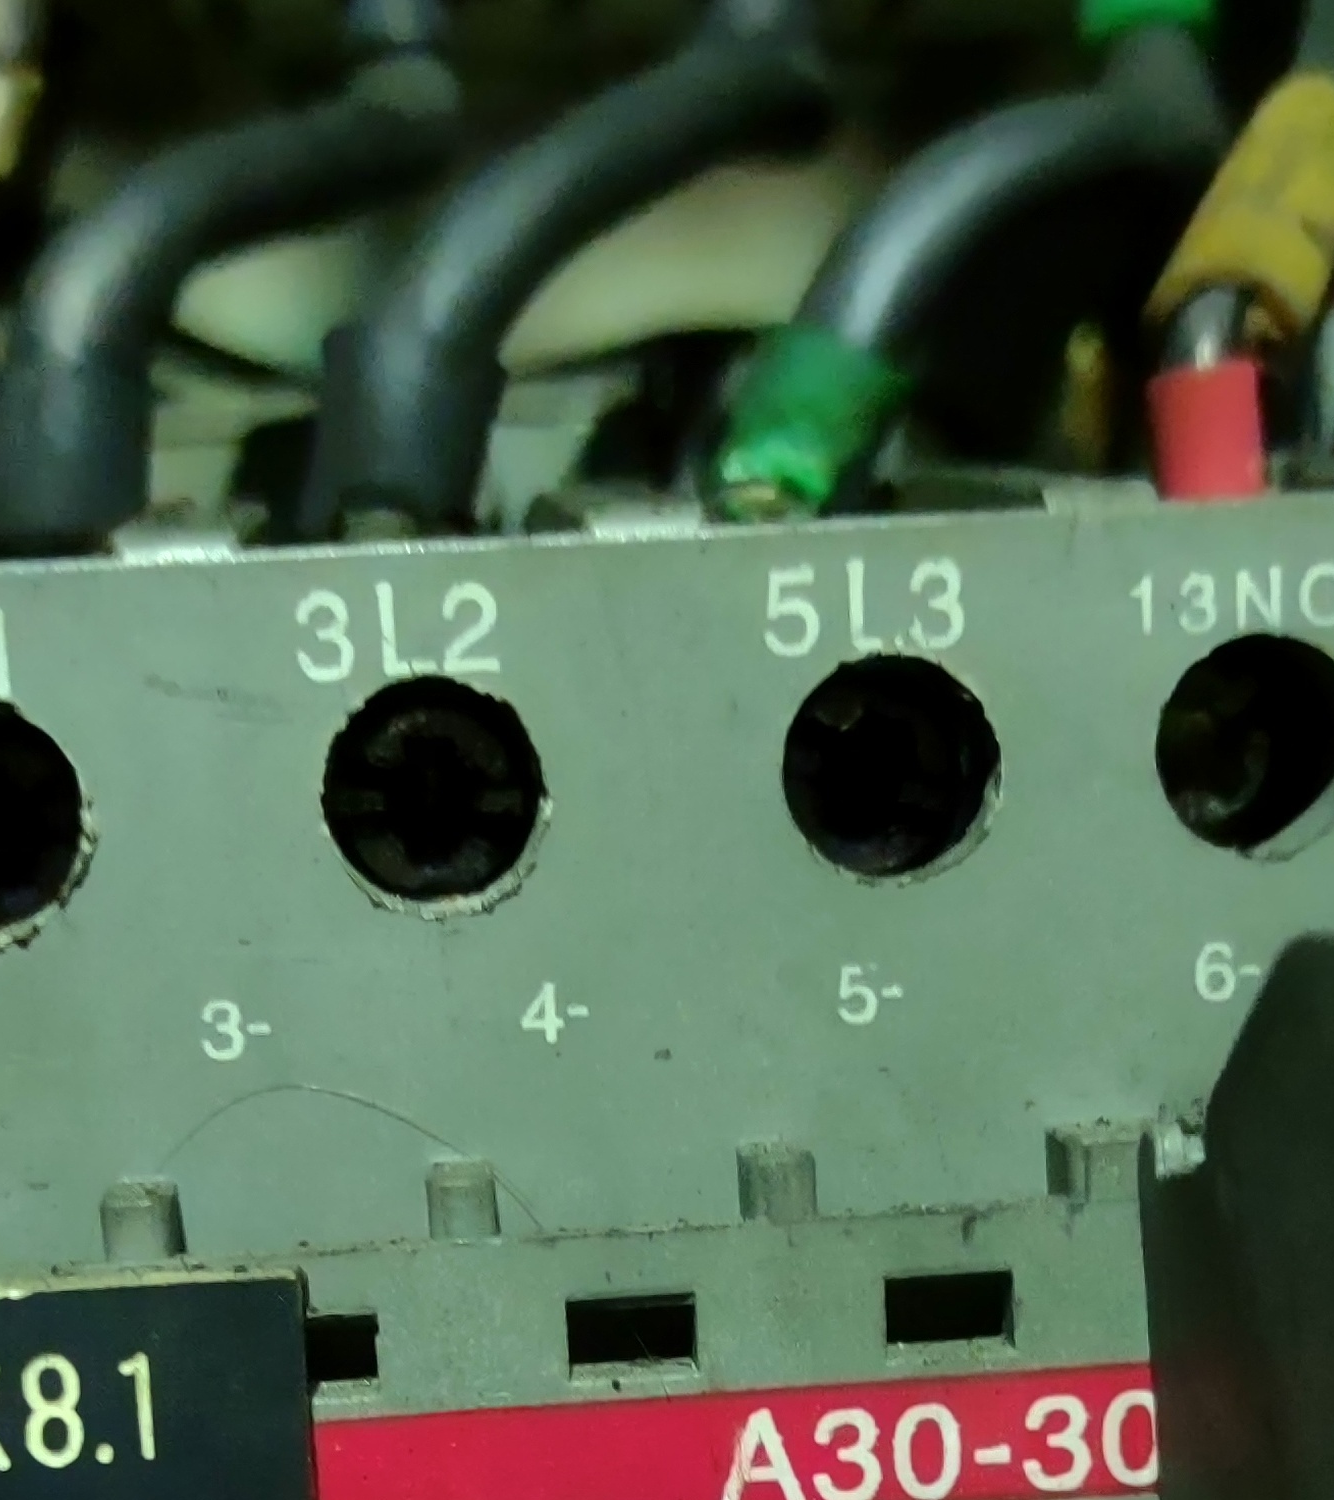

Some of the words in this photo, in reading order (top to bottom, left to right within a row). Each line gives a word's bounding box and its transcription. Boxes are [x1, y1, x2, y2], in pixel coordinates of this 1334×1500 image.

[295, 581, 501, 682] 3L2
[763, 557, 965, 656] 5L3
[837, 965, 904, 1025] 5-
[1193, 941, 1262, 1002] 6-
[201, 998, 272, 1061] 3-
[520, 981, 590, 1043] 4-
